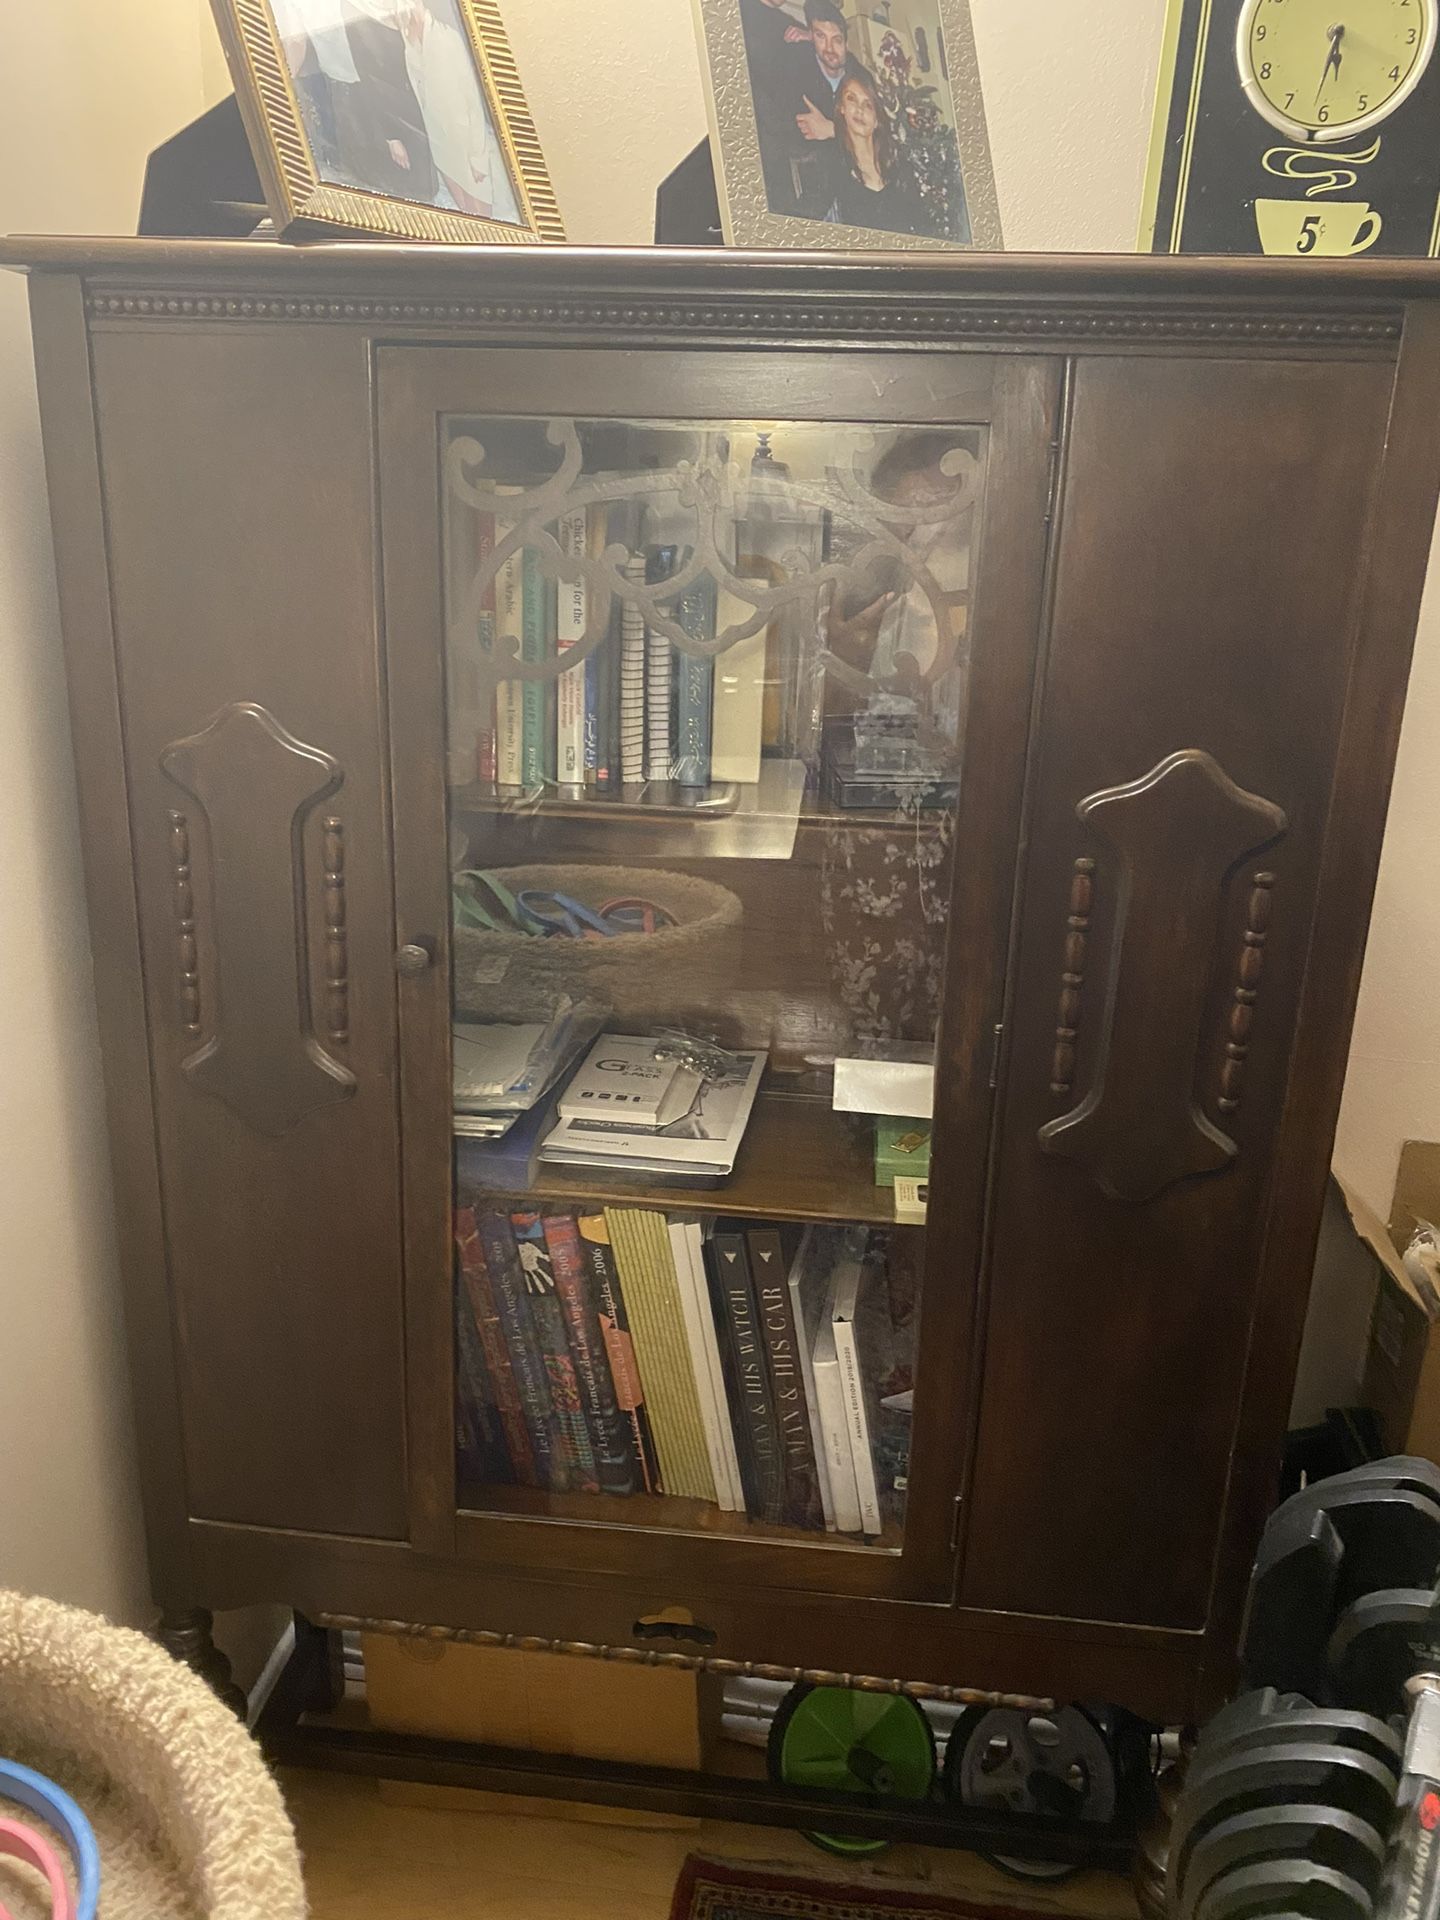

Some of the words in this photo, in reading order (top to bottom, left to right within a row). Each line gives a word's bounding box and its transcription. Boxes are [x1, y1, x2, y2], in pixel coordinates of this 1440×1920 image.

[1256, 25, 1267, 41] 9
[1405, 28, 1416, 45] 3
[1260, 62, 1272, 80] 8
[1388, 65, 1400, 82] 4
[1284, 93, 1295, 110] 7
[1357, 95, 1368, 112] 5
[1318, 105, 1329, 122] 6
[504, 581, 515, 615] Arabic
[573, 588, 584, 606] for
[573, 608, 584, 625] the
[592, 1248, 606, 1275] 2006
[500, 1272, 518, 1316] Angeles
[567, 1284, 583, 1327] Angeles
[600, 1283, 616, 1330] Angeles
[762, 1287, 786, 1331] CAR
[729, 1289, 754, 1354] WATCH
[576, 1329, 587, 1351] Los
[580, 1353, 591, 1367] de
[614, 1351, 625, 1365] de
[771, 1339, 794, 1377] HIS
[744, 1363, 762, 1395] HIS
[584, 1370, 601, 1415] Français
[779, 1387, 799, 1401] &
[849, 1383, 858, 1410] EDITION
[751, 1403, 766, 1415] &
[594, 1419, 609, 1448] Lycée
[783, 1410, 806, 1455] MAN
[854, 1412, 862, 1439] ANNUAL
[600, 1450, 611, 1463] Le
